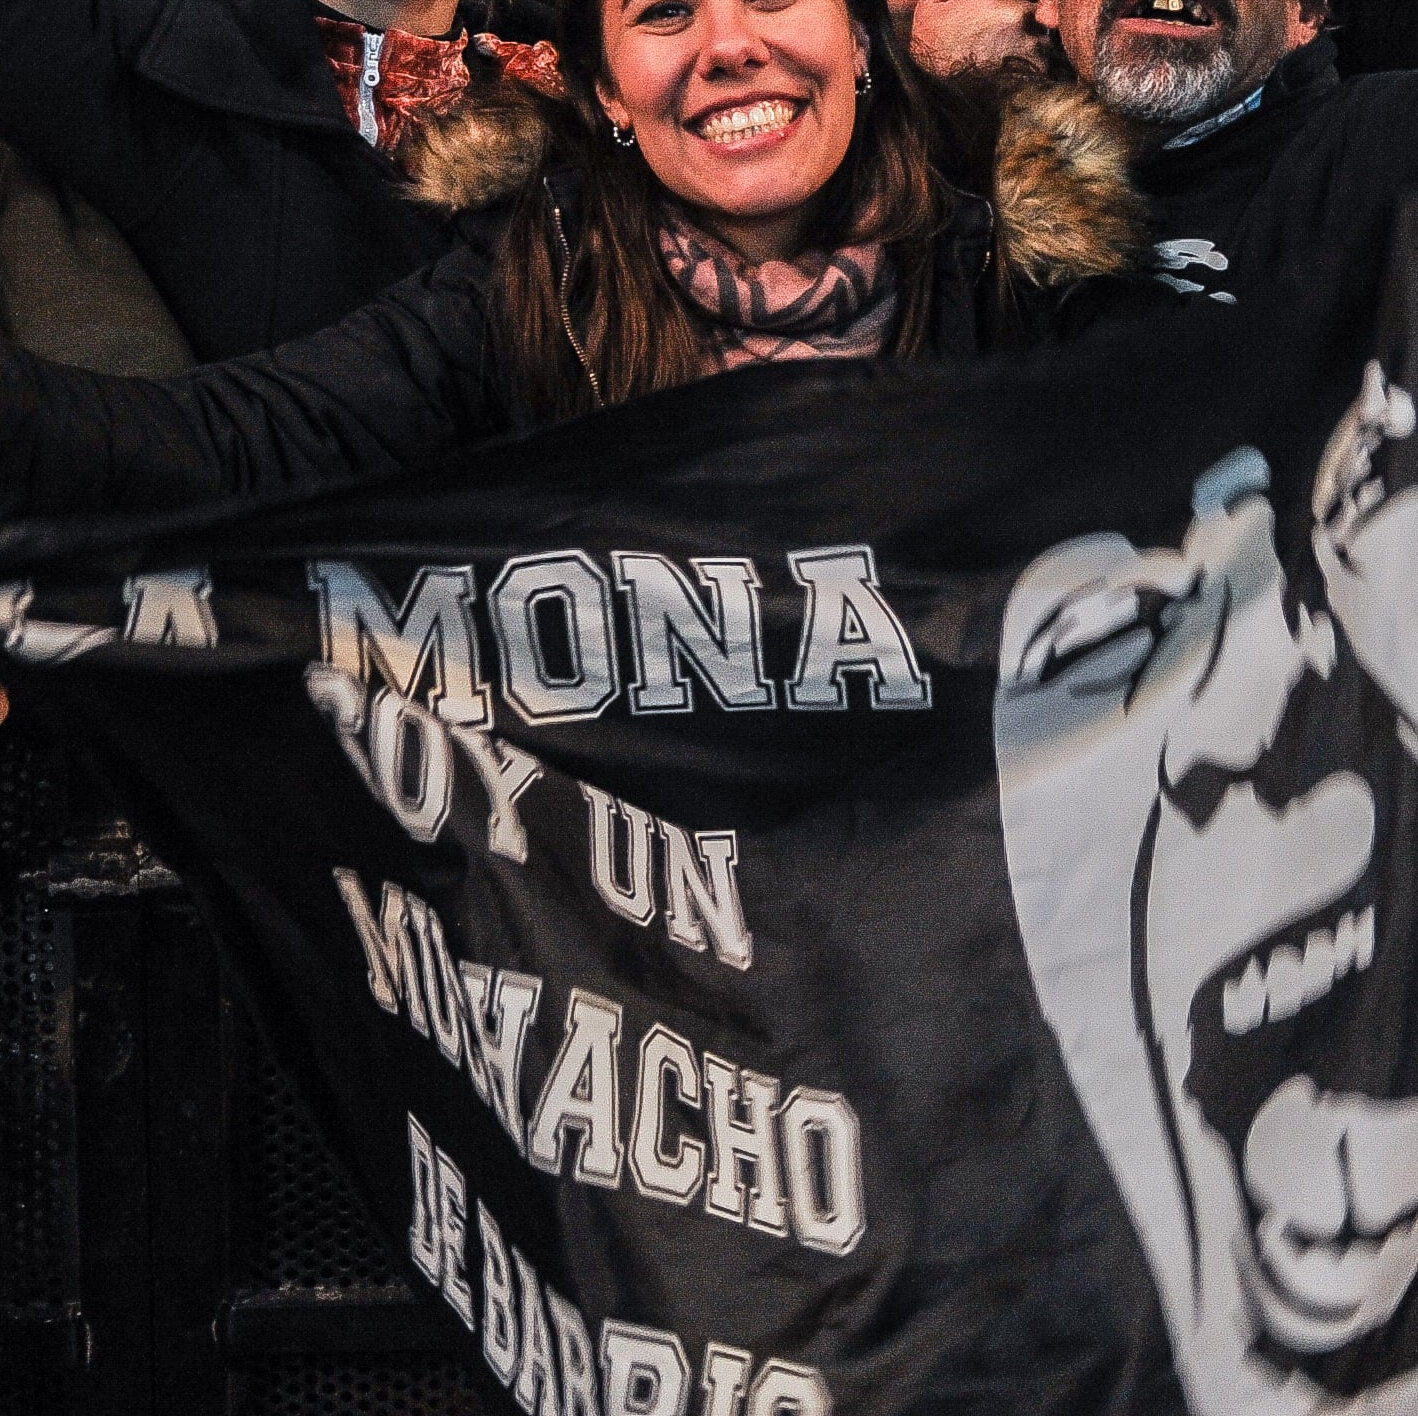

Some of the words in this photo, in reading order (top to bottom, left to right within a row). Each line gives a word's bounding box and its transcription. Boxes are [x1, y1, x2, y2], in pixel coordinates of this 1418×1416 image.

[306, 545, 933, 732] MONA
[579, 781, 753, 972] UN
[408, 1110, 475, 1333] DE
